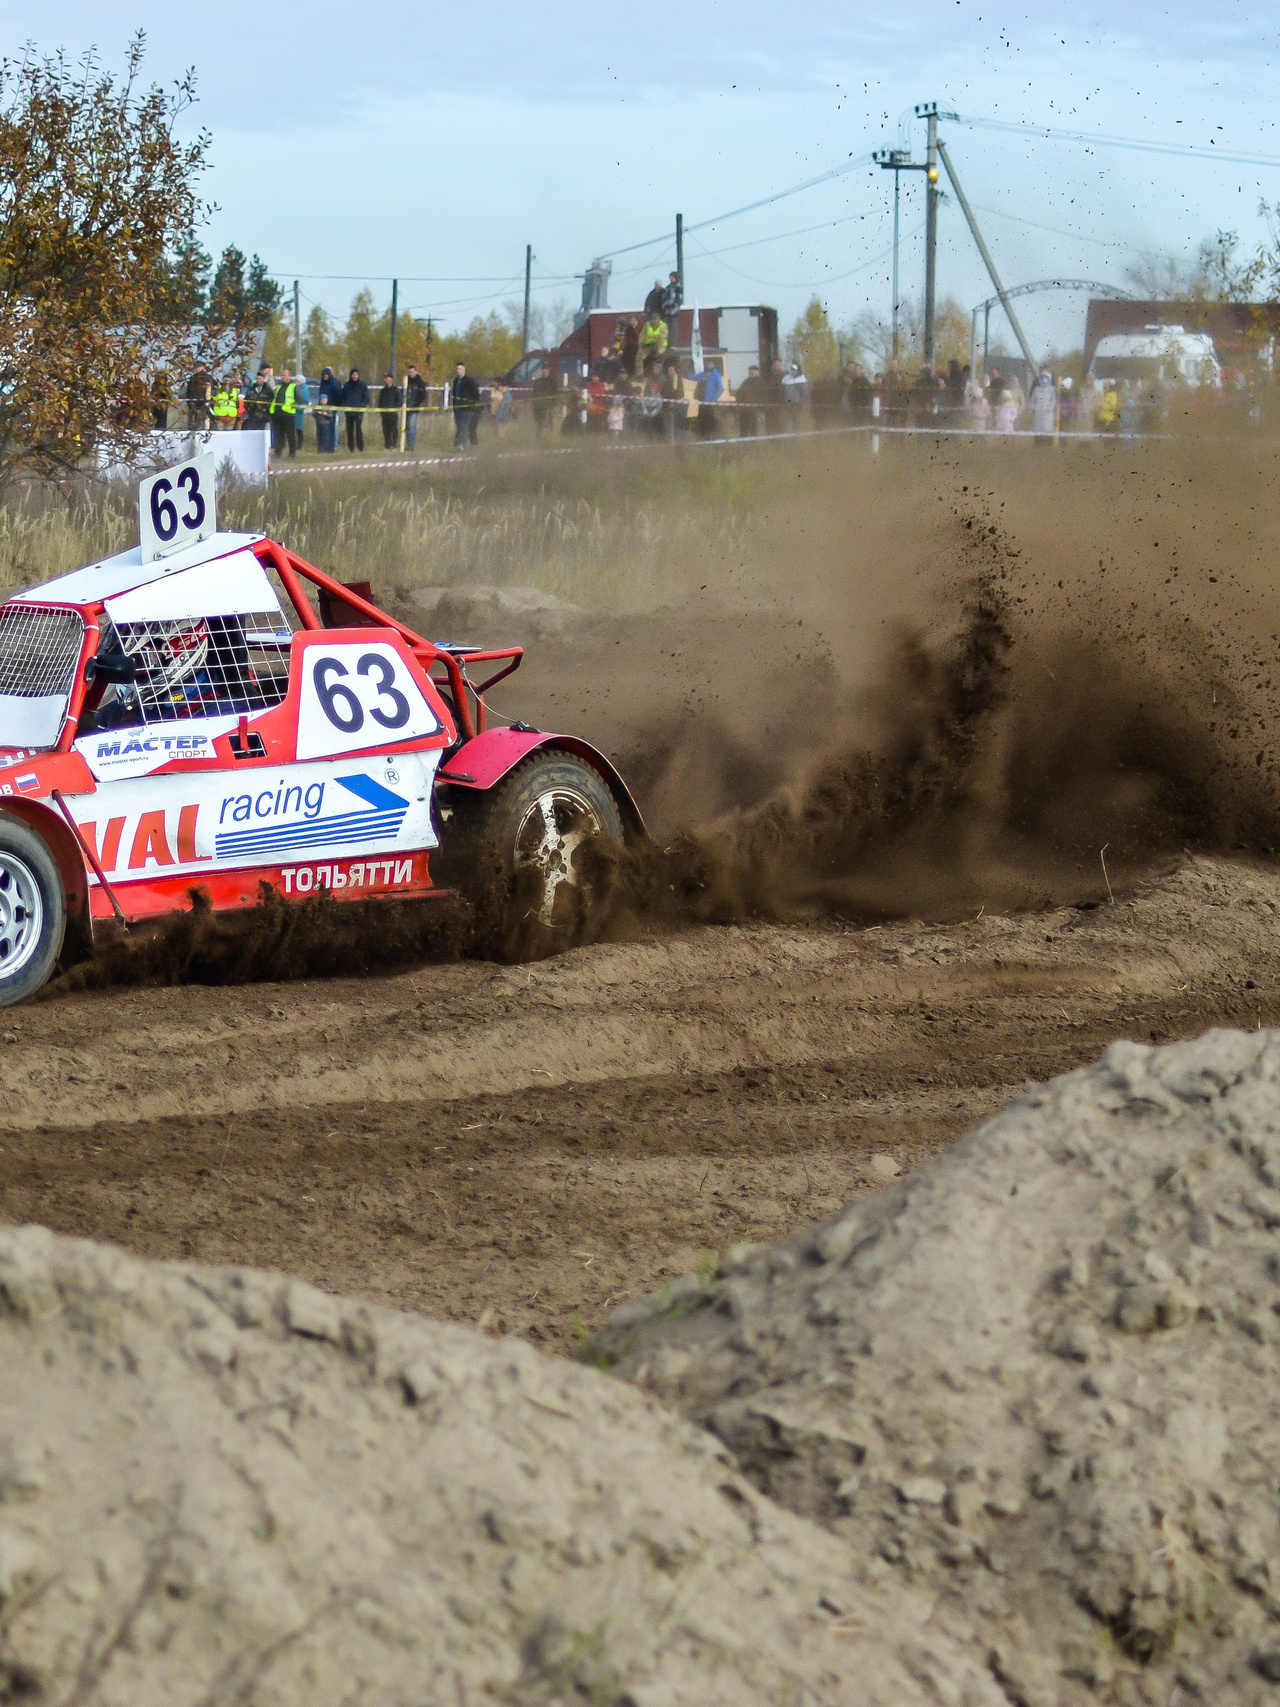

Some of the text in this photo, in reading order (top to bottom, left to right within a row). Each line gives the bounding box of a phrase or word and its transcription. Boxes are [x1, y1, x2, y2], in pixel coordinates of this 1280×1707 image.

[150, 466, 206, 542] 63
[312, 653, 411, 734] 63
[97, 735, 209, 758] МАСТЕР
[168, 750, 208, 759] СПОРТ
[219, 780, 326, 824] racing
[78, 803, 213, 874] VAL
[281, 859, 413, 893] ТОЛЬЯТТИ
